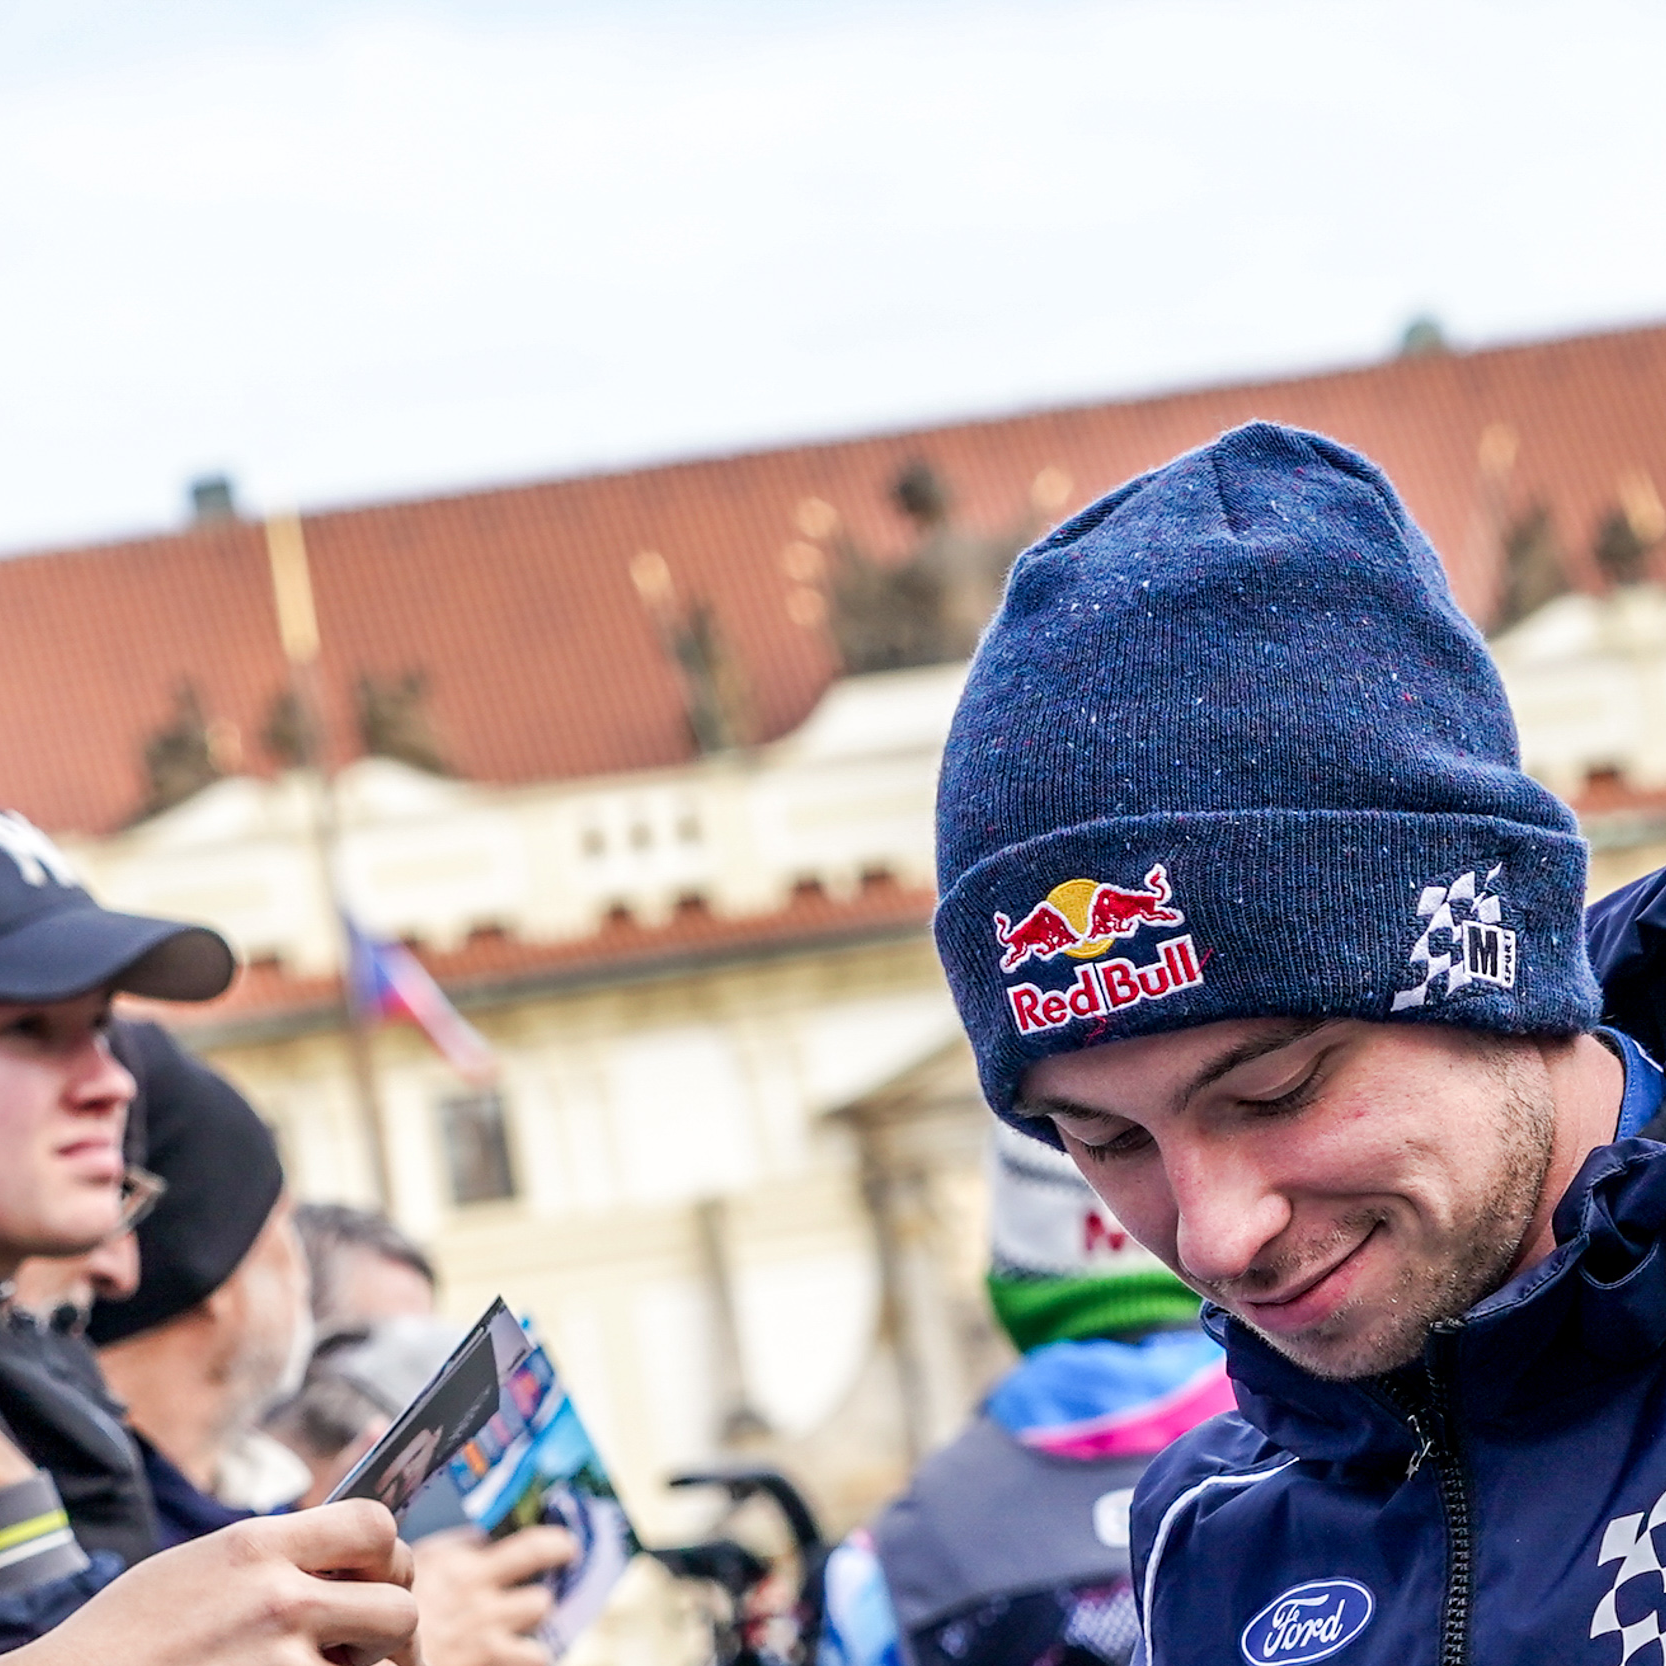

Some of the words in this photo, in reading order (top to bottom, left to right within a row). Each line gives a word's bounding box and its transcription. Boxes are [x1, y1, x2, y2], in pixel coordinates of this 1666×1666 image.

[1467, 925, 1499, 979] M
[1012, 969, 1101, 1032] Red
[1101, 941, 1198, 1009] Bull
[1262, 1592, 1348, 1658] Ford
